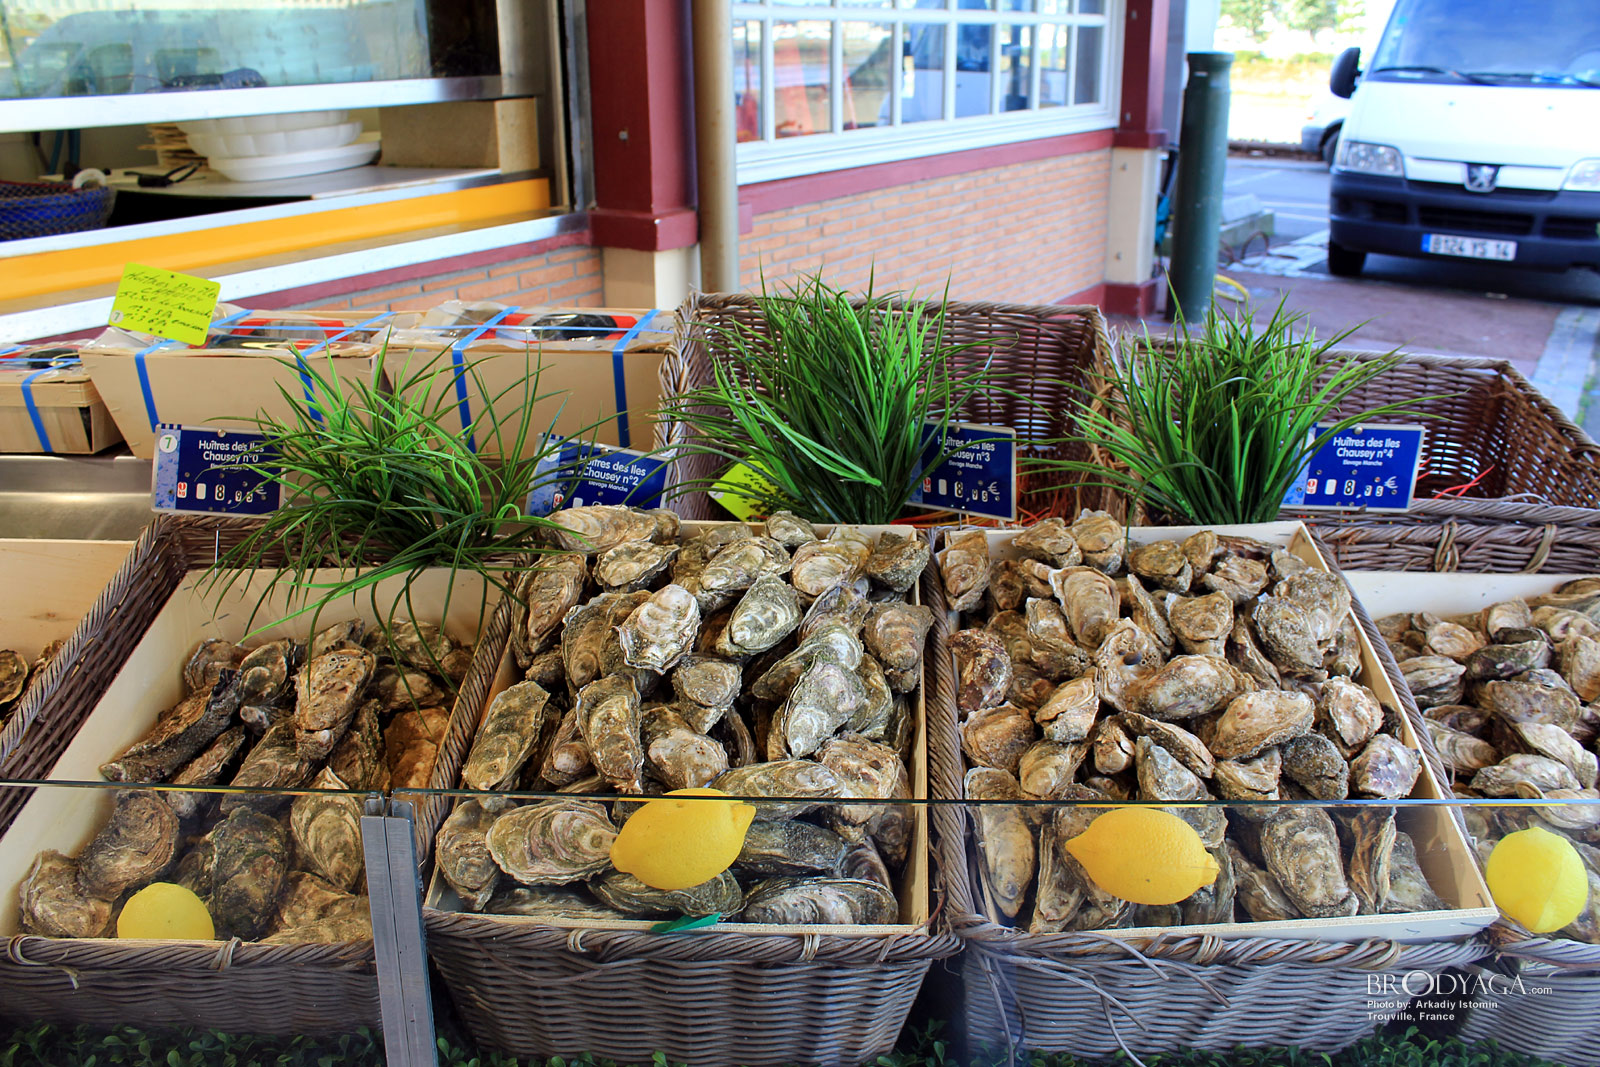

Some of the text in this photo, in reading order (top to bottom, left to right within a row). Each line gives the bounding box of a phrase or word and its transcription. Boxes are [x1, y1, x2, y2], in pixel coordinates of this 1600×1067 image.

[198, 439, 230, 451] Huîtres
[232, 441, 248, 452] des
[1333, 437, 1400, 448] Huîtres des Iles
[203, 451, 241, 464] Chausey
[976, 452, 991, 462] n°3
[1336, 448, 1394, 460] Chausey n°4
[612, 460, 629, 472] des
[630, 463, 646, 477] Iles
[622, 474, 640, 486] n°2
